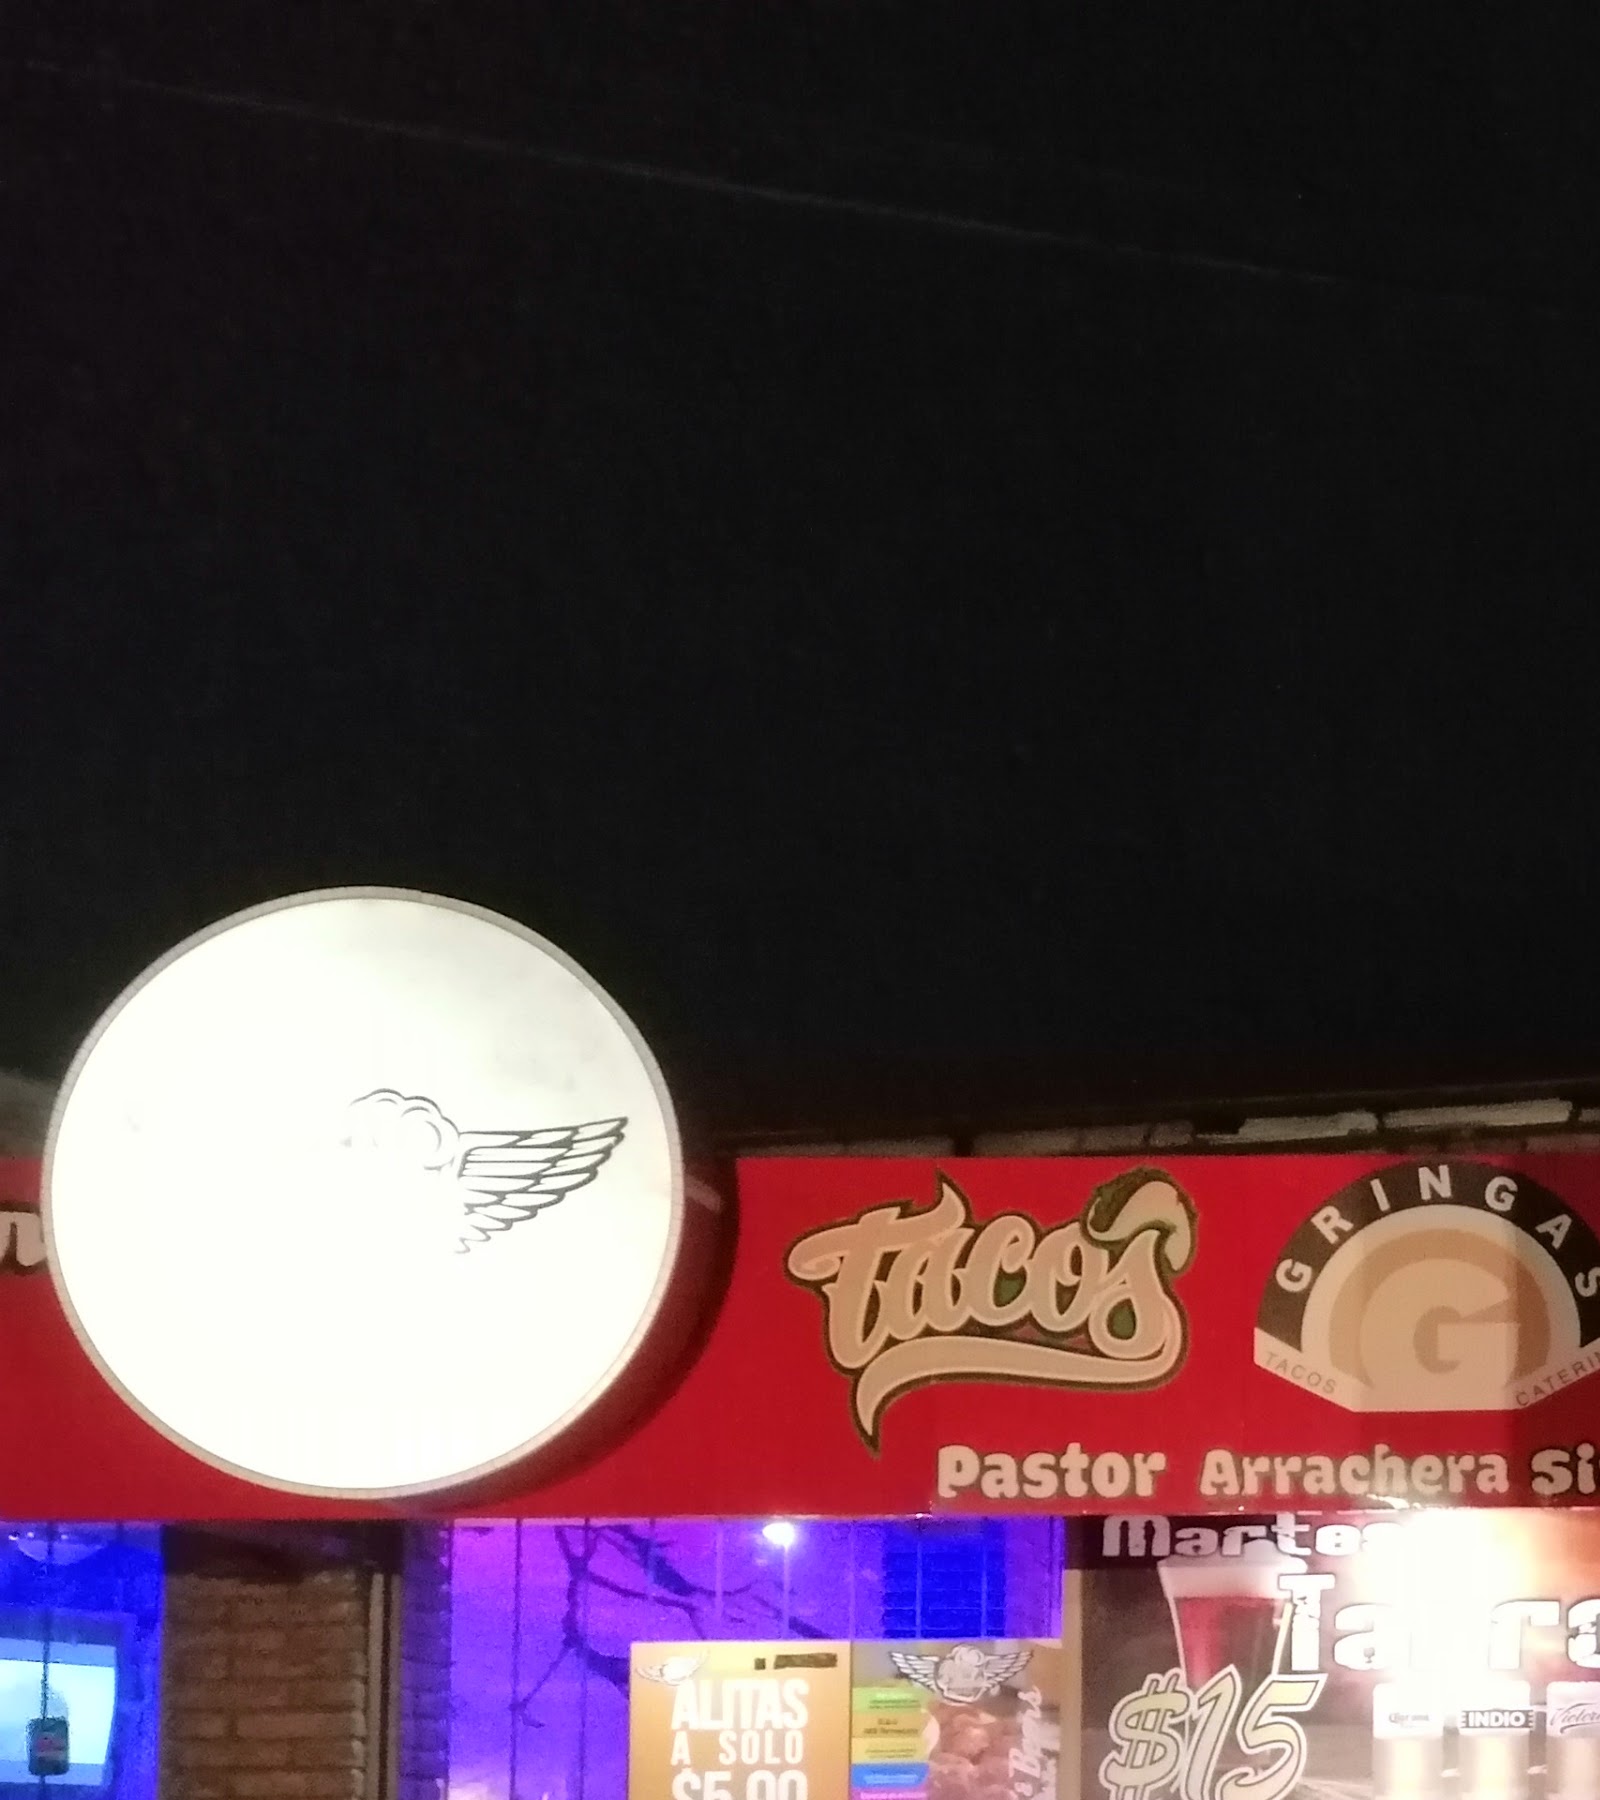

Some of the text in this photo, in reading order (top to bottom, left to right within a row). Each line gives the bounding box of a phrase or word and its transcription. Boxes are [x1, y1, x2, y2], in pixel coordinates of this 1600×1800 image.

[787, 1168, 1192, 1452] Tacos
[1260, 1349, 1338, 1396] TACOS
[938, 1443, 1166, 1499] Pastor
[1200, 1444, 1509, 1496] Arrachera
[671, 1677, 809, 1730] ALITAS
[1468, 1711, 1525, 1728] INDIO
[670, 1729, 804, 1766] A SOLO
